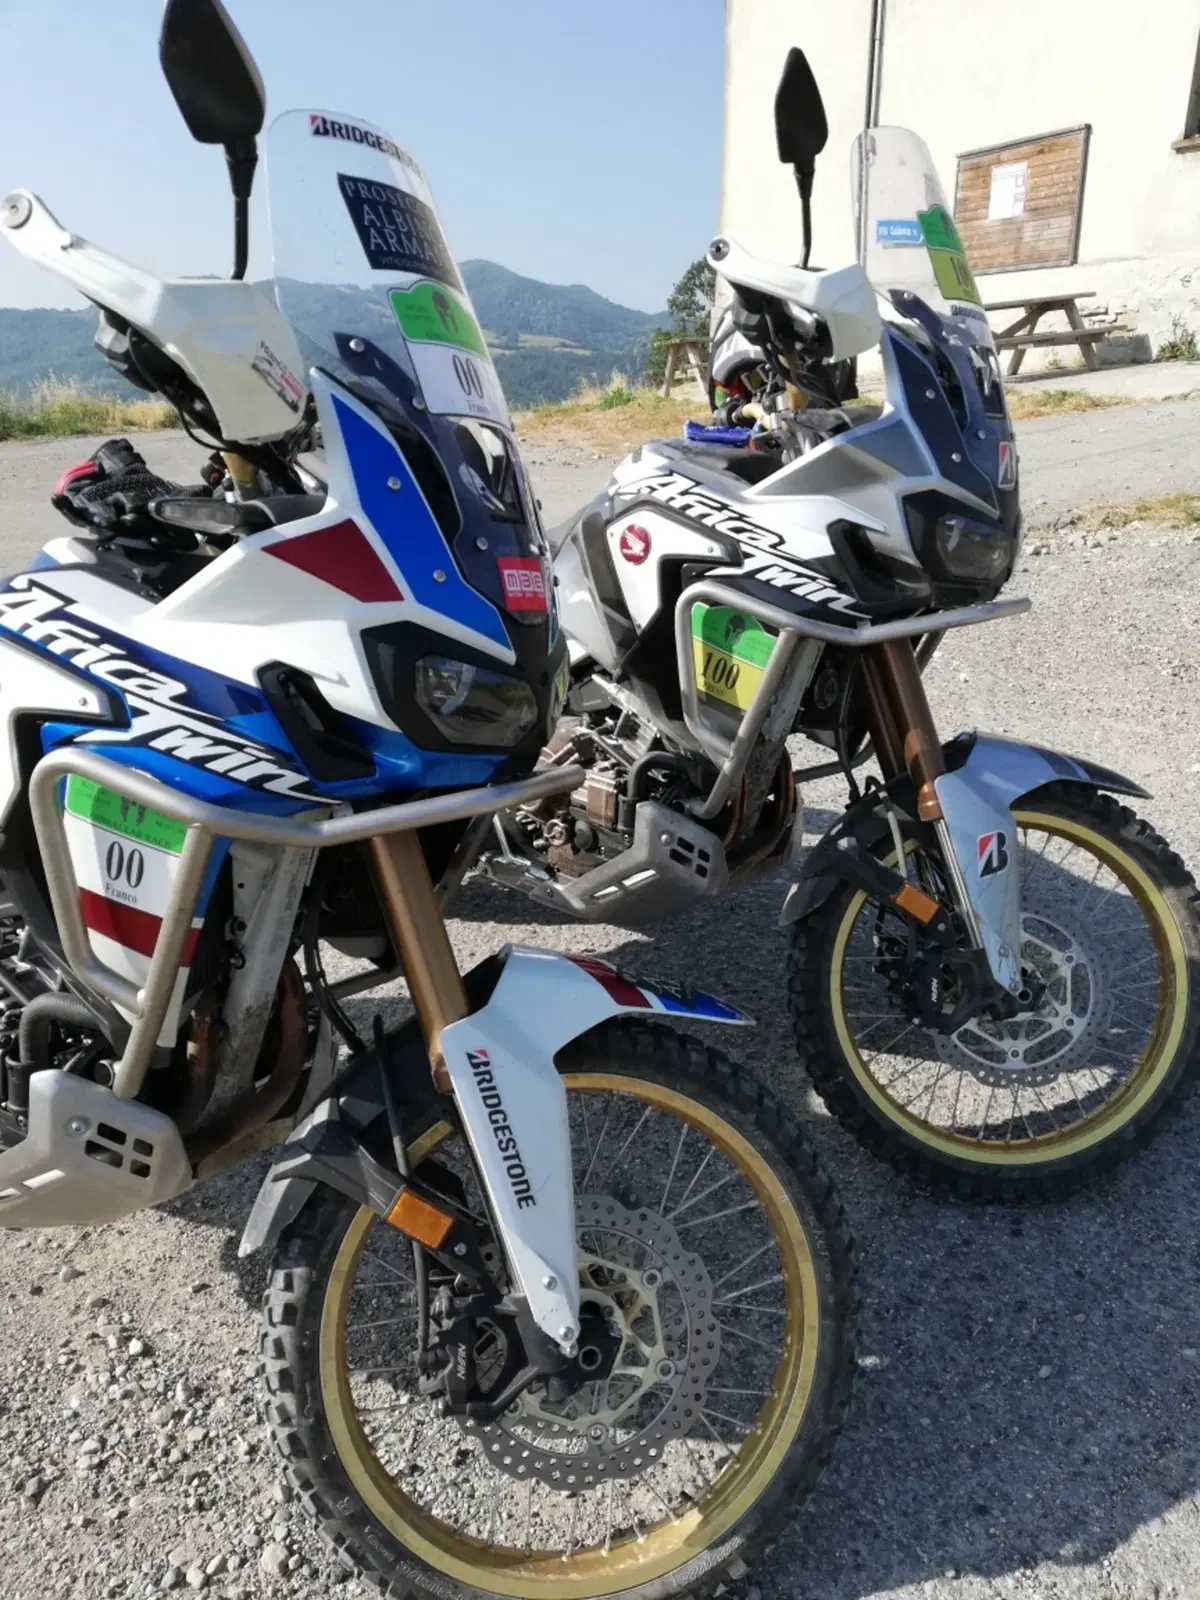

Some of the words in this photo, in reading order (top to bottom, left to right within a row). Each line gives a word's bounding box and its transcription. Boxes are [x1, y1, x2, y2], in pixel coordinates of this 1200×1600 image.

[310, 115, 424, 180] BRIDGEST
[344, 181, 429, 216] PROSEC
[363, 203, 440, 246] ALBIN
[370, 227, 450, 268] ARMA
[452, 354, 484, 399] 00
[636, 472, 809, 562] Africa
[703, 541, 874, 619] Twin
[0, 578, 228, 723] Africa
[700, 651, 740, 690] 100
[72, 692, 342, 804] Twin
[106, 841, 144, 888] 00
[105, 883, 138, 904] Franco
[466, 1048, 536, 1210] BRIDGESTONE
